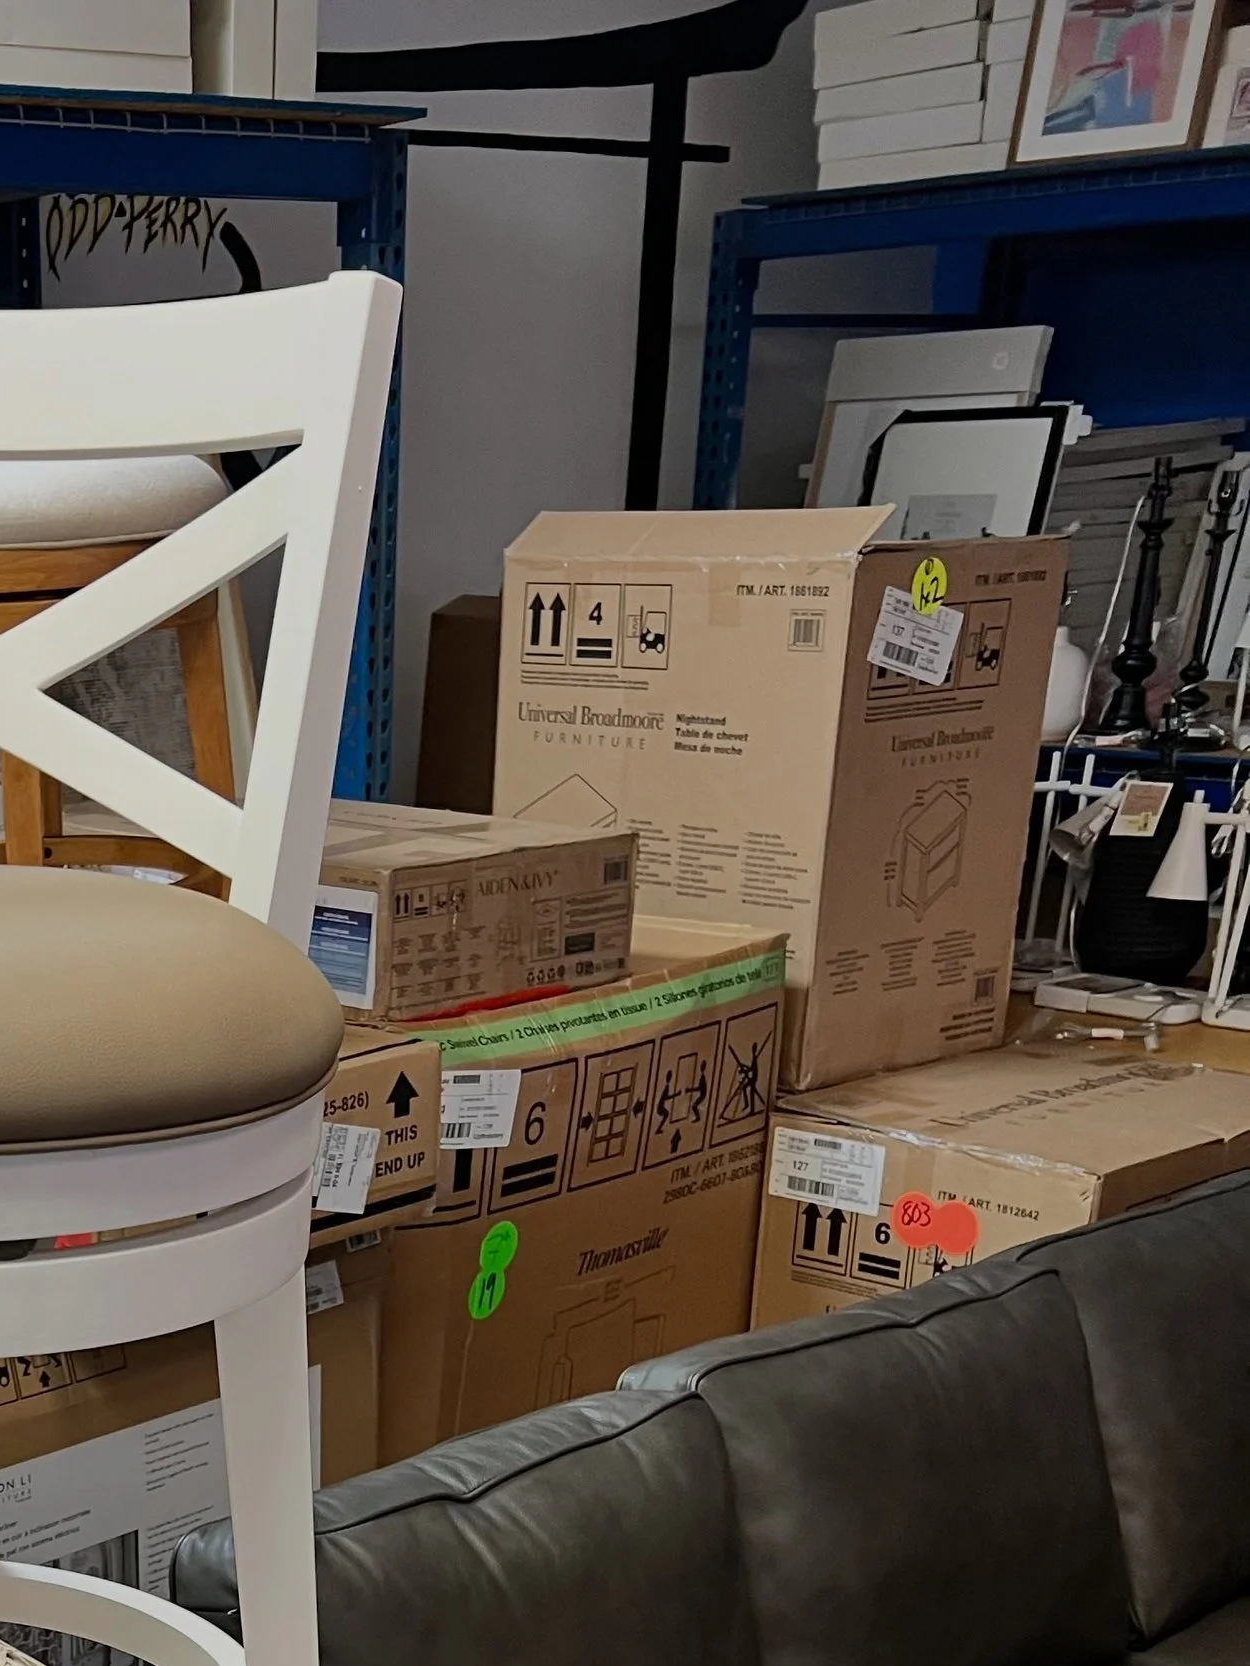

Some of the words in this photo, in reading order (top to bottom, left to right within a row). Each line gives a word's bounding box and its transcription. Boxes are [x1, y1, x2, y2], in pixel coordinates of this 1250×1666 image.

[588, 601, 603, 625] 4
[518, 701, 578, 723] Universal
[533, 730, 647, 750] FURNITURE
[385, 1124, 418, 1147] THIS
[524, 1101, 547, 1146] 6
[374, 1158, 403, 1178] END
[407, 1151, 426, 1170] UP
[901, 1199, 932, 1228] 803
[874, 1221, 891, 1246] 6
[577, 1226, 670, 1277] Thomasville
